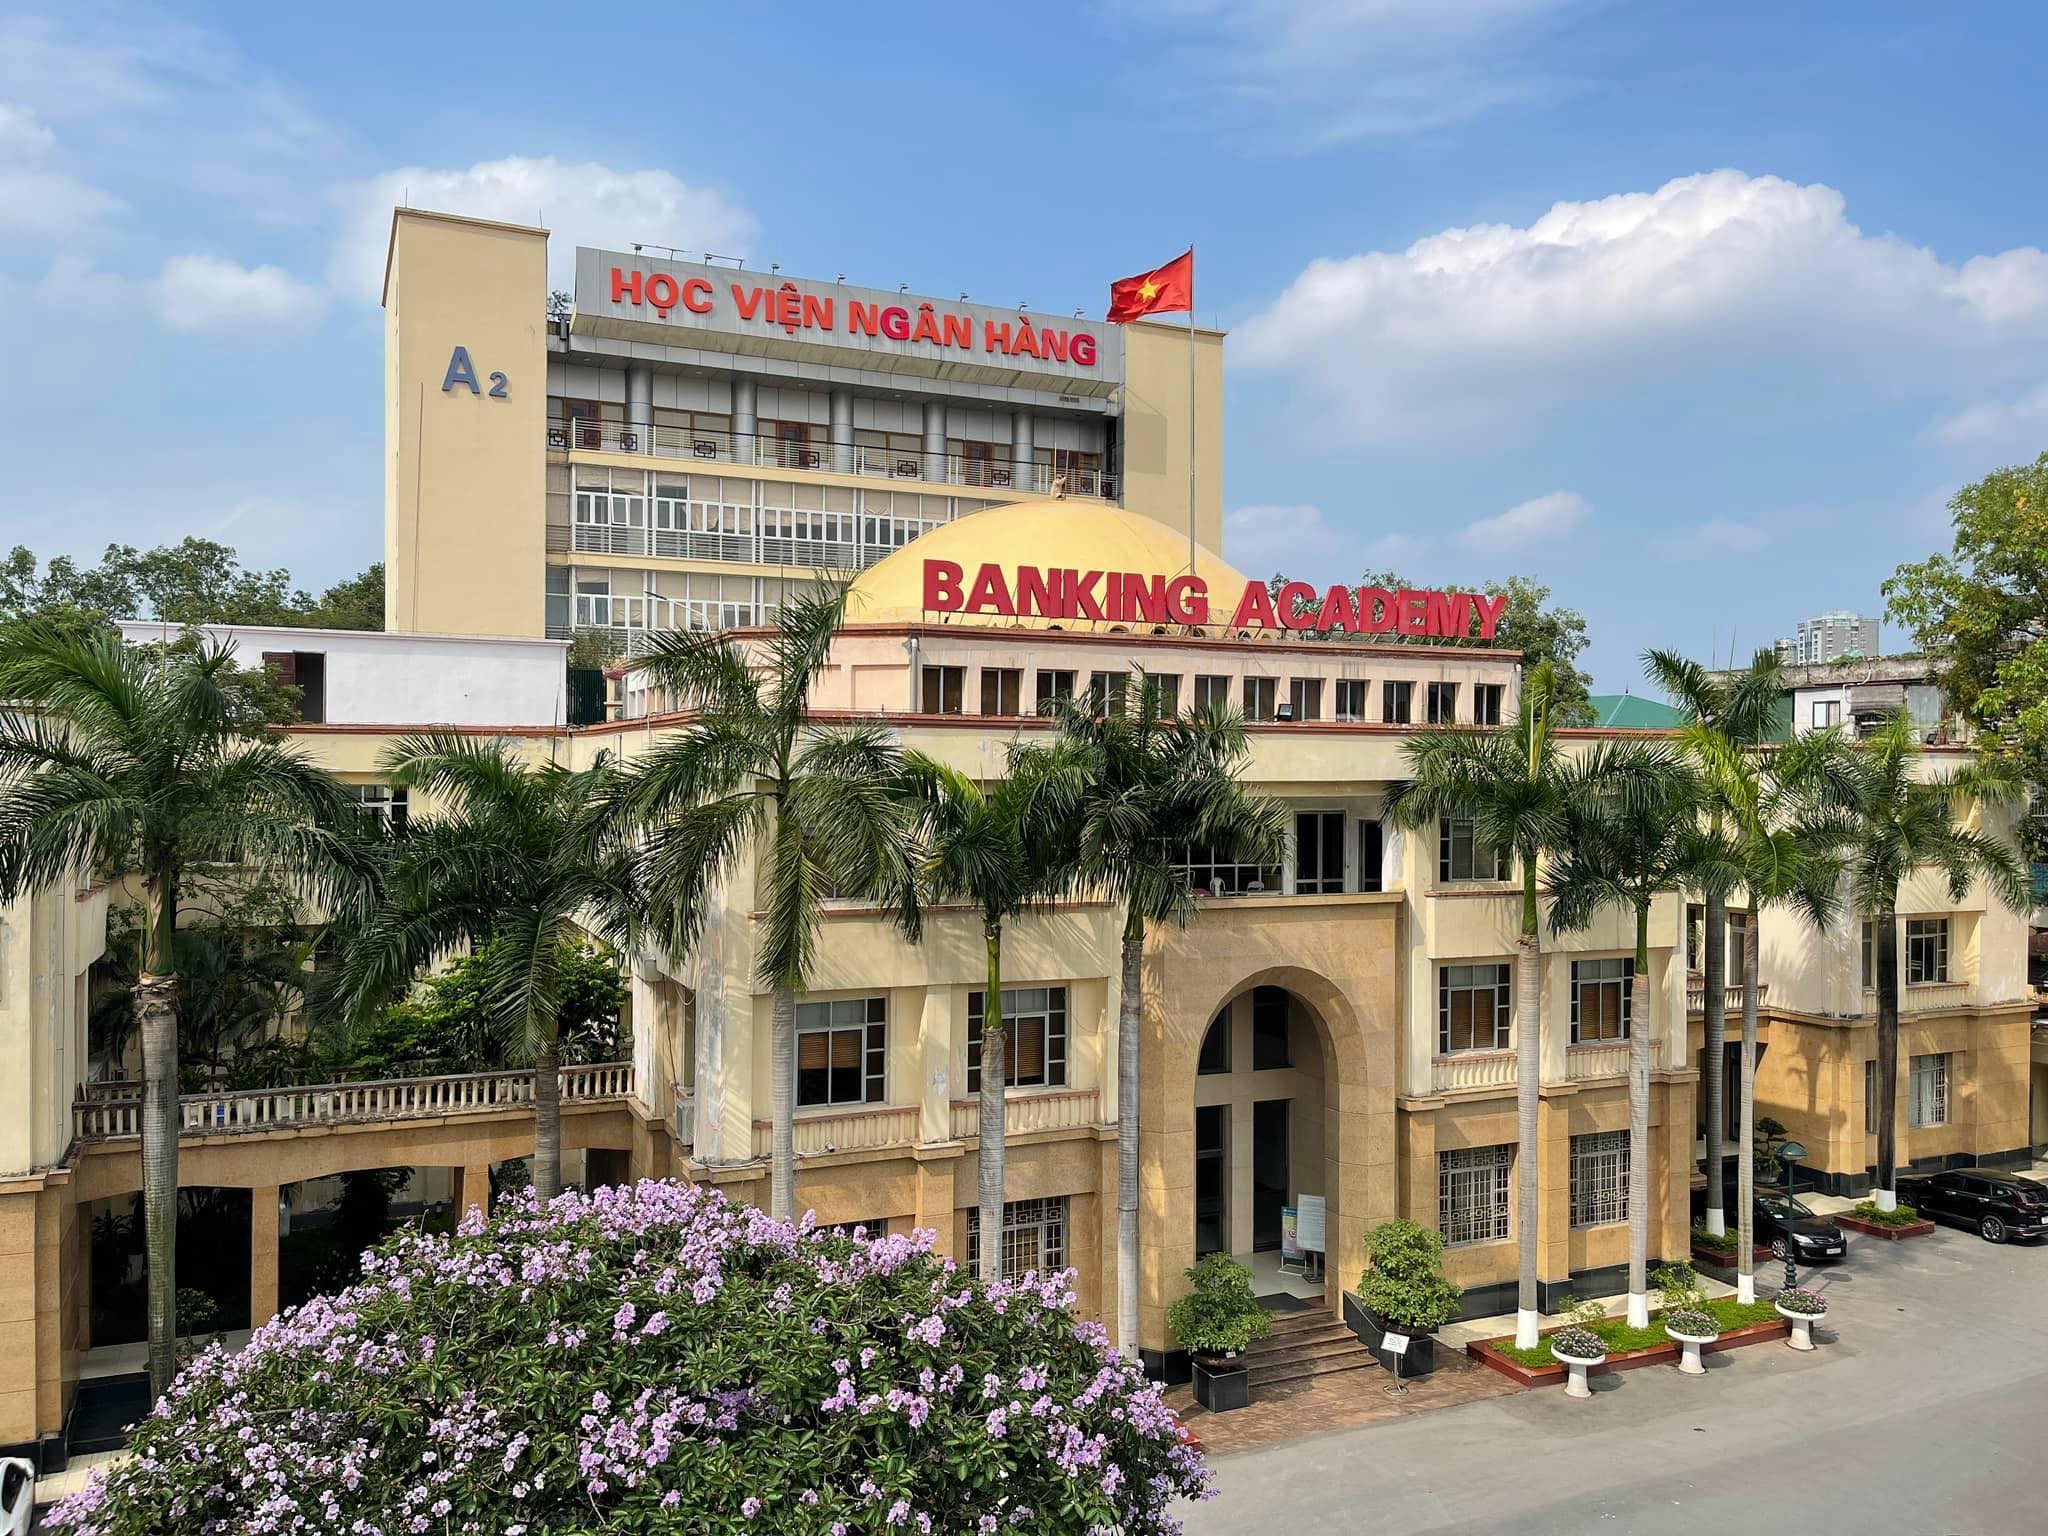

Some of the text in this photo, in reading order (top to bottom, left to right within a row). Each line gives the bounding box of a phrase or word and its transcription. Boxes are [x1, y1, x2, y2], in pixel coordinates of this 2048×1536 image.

[610, 266, 1097, 366] HỌC VIỆN NGÂN HÀNG
[922, 558, 1509, 641] BANKING ACADEMY
